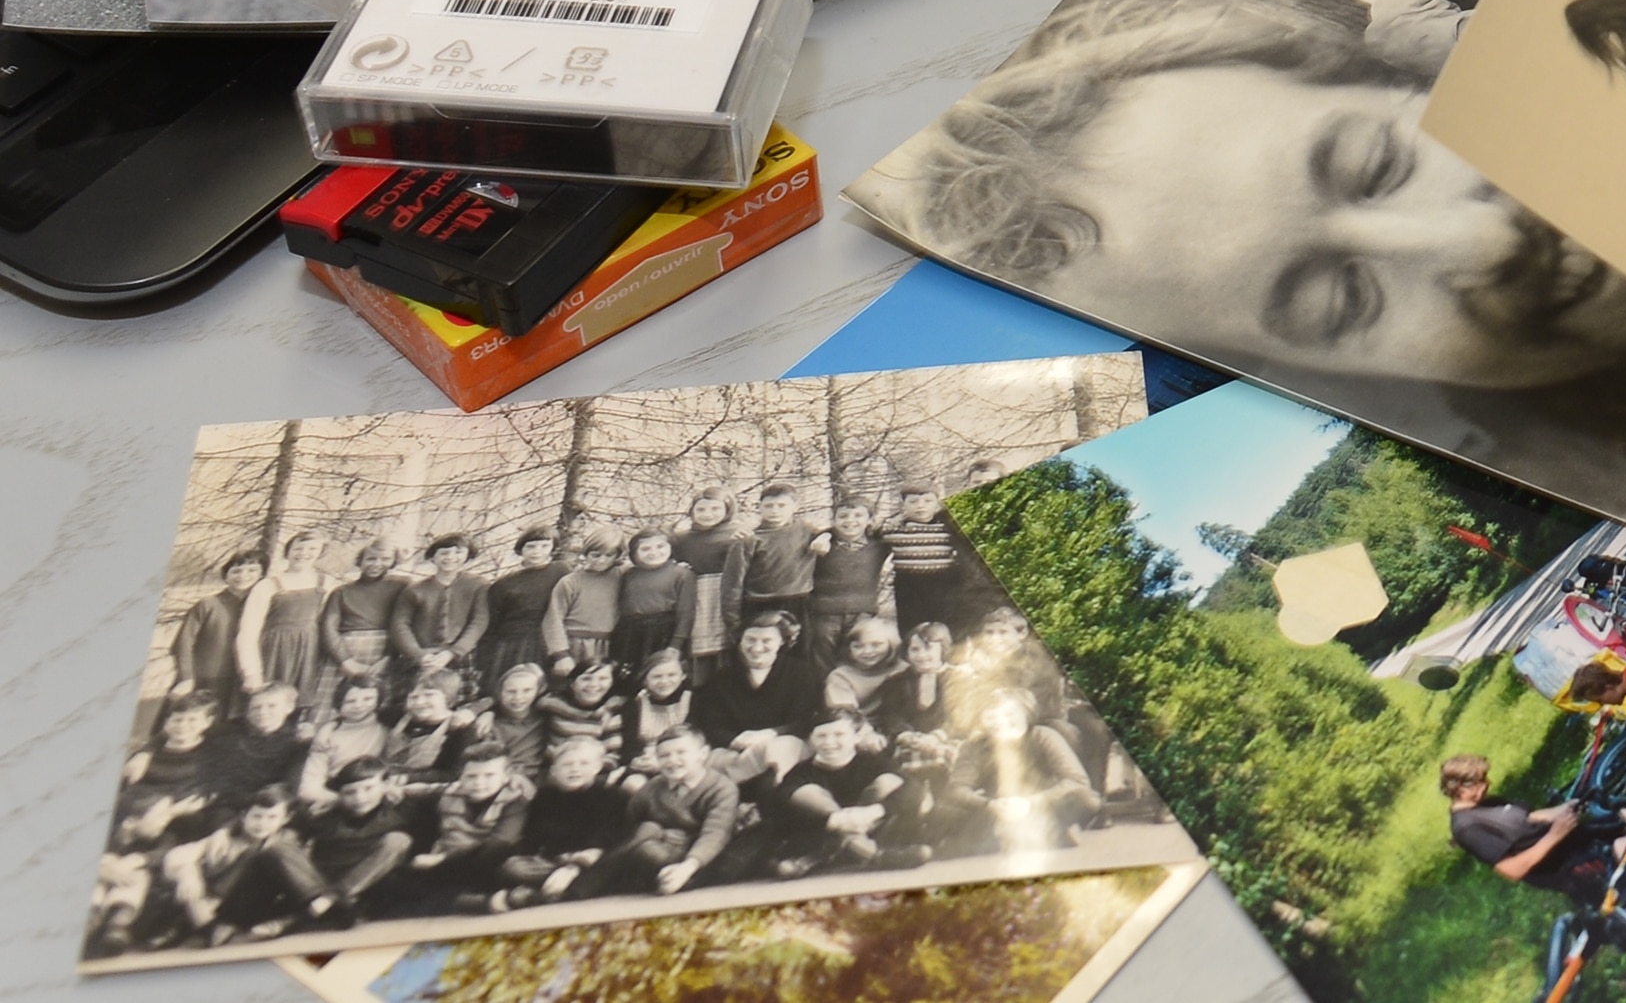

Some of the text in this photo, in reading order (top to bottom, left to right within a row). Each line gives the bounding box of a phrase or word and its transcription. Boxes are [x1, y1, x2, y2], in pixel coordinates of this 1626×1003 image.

[356, 74, 423, 87] SP MODE
[453, 81, 519, 93] LP MODE
[364, 168, 429, 219] SONY
[719, 169, 810, 231] SONY
